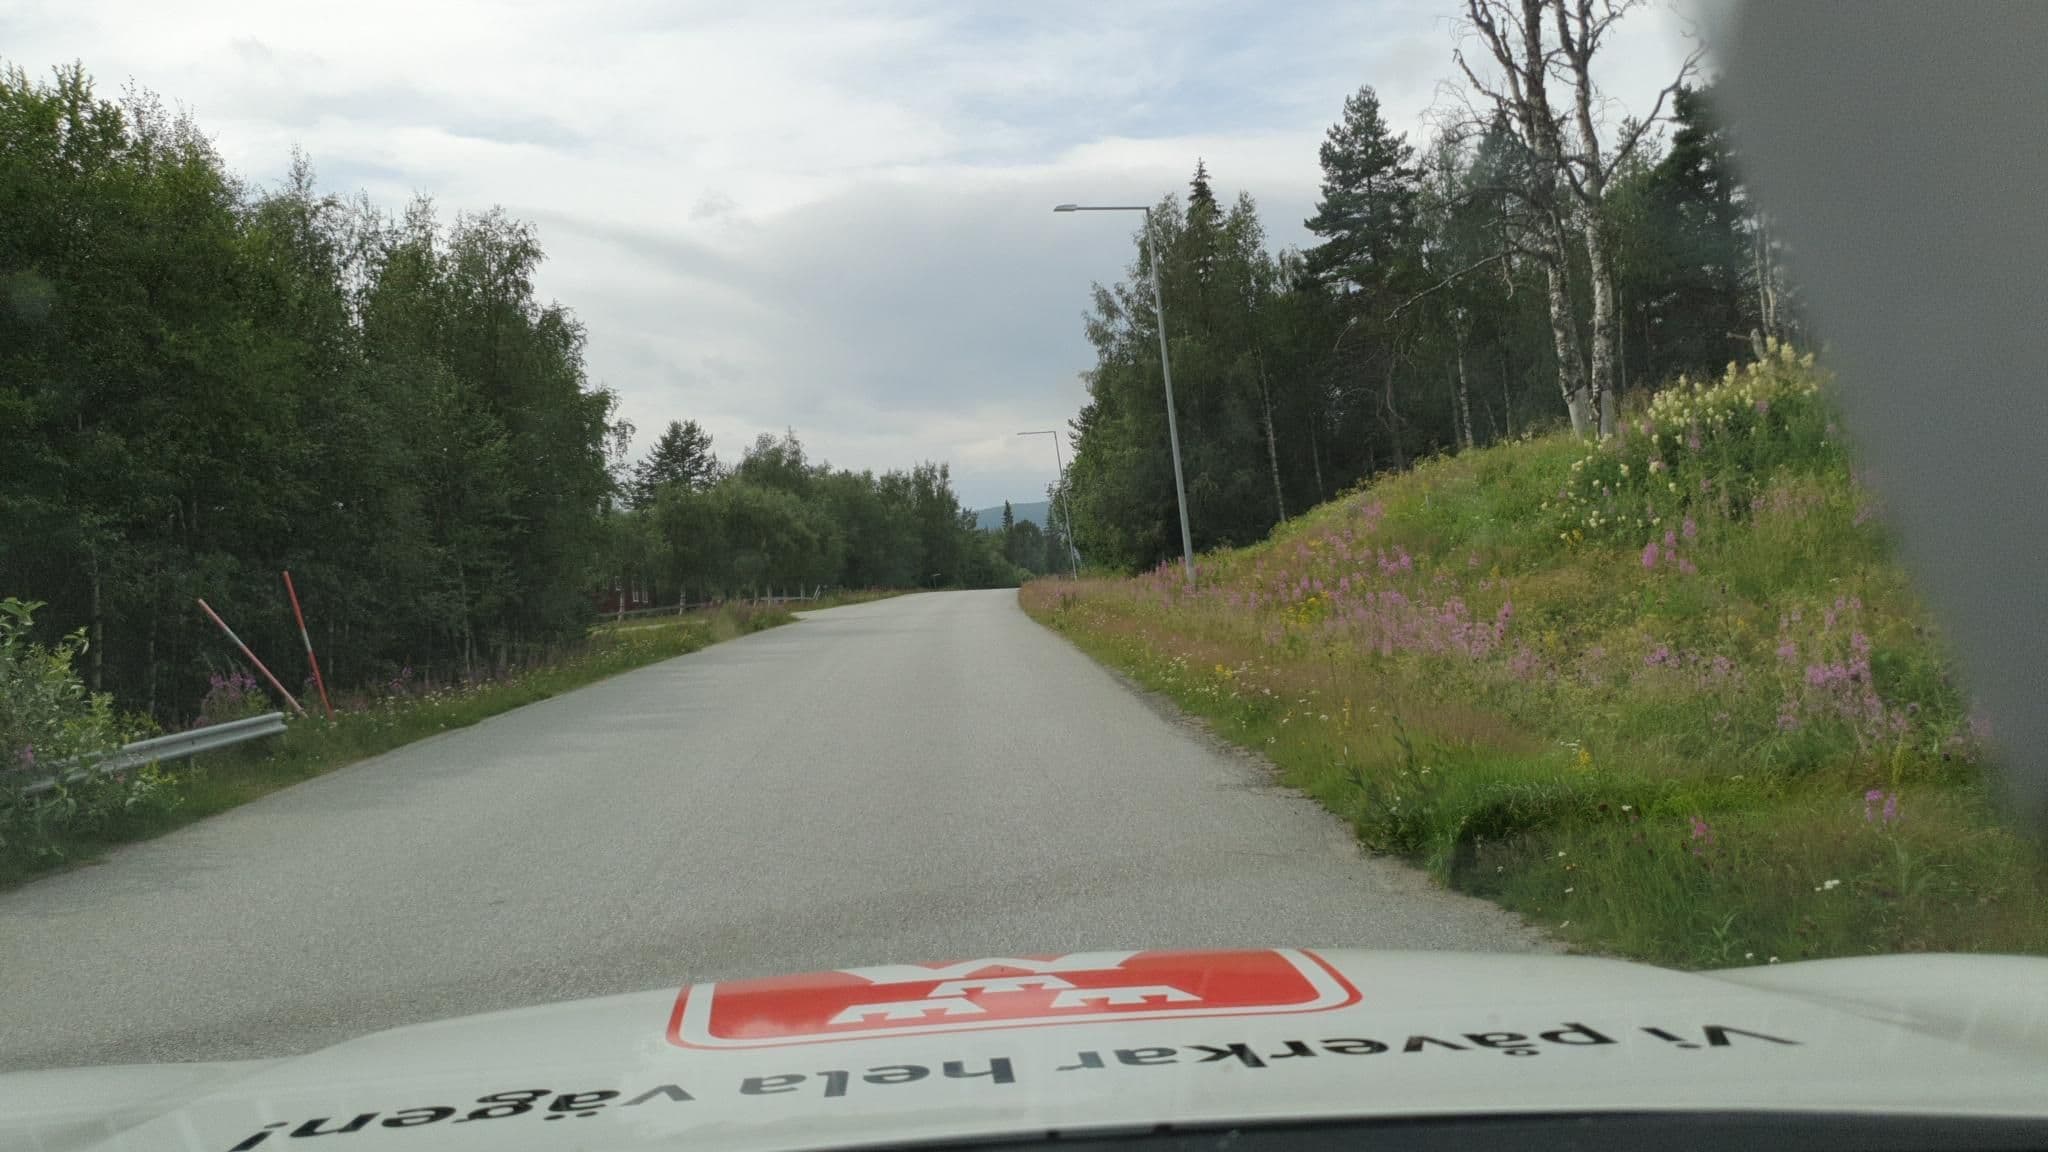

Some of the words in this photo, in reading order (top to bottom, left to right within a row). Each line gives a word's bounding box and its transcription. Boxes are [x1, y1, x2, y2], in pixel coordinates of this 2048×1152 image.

[1056, 1022, 1618, 1069] påverkar
[1639, 1025, 1806, 1049] Vi
[739, 1057, 1016, 1098] hela
[227, 1083, 697, 1152] vägen!
